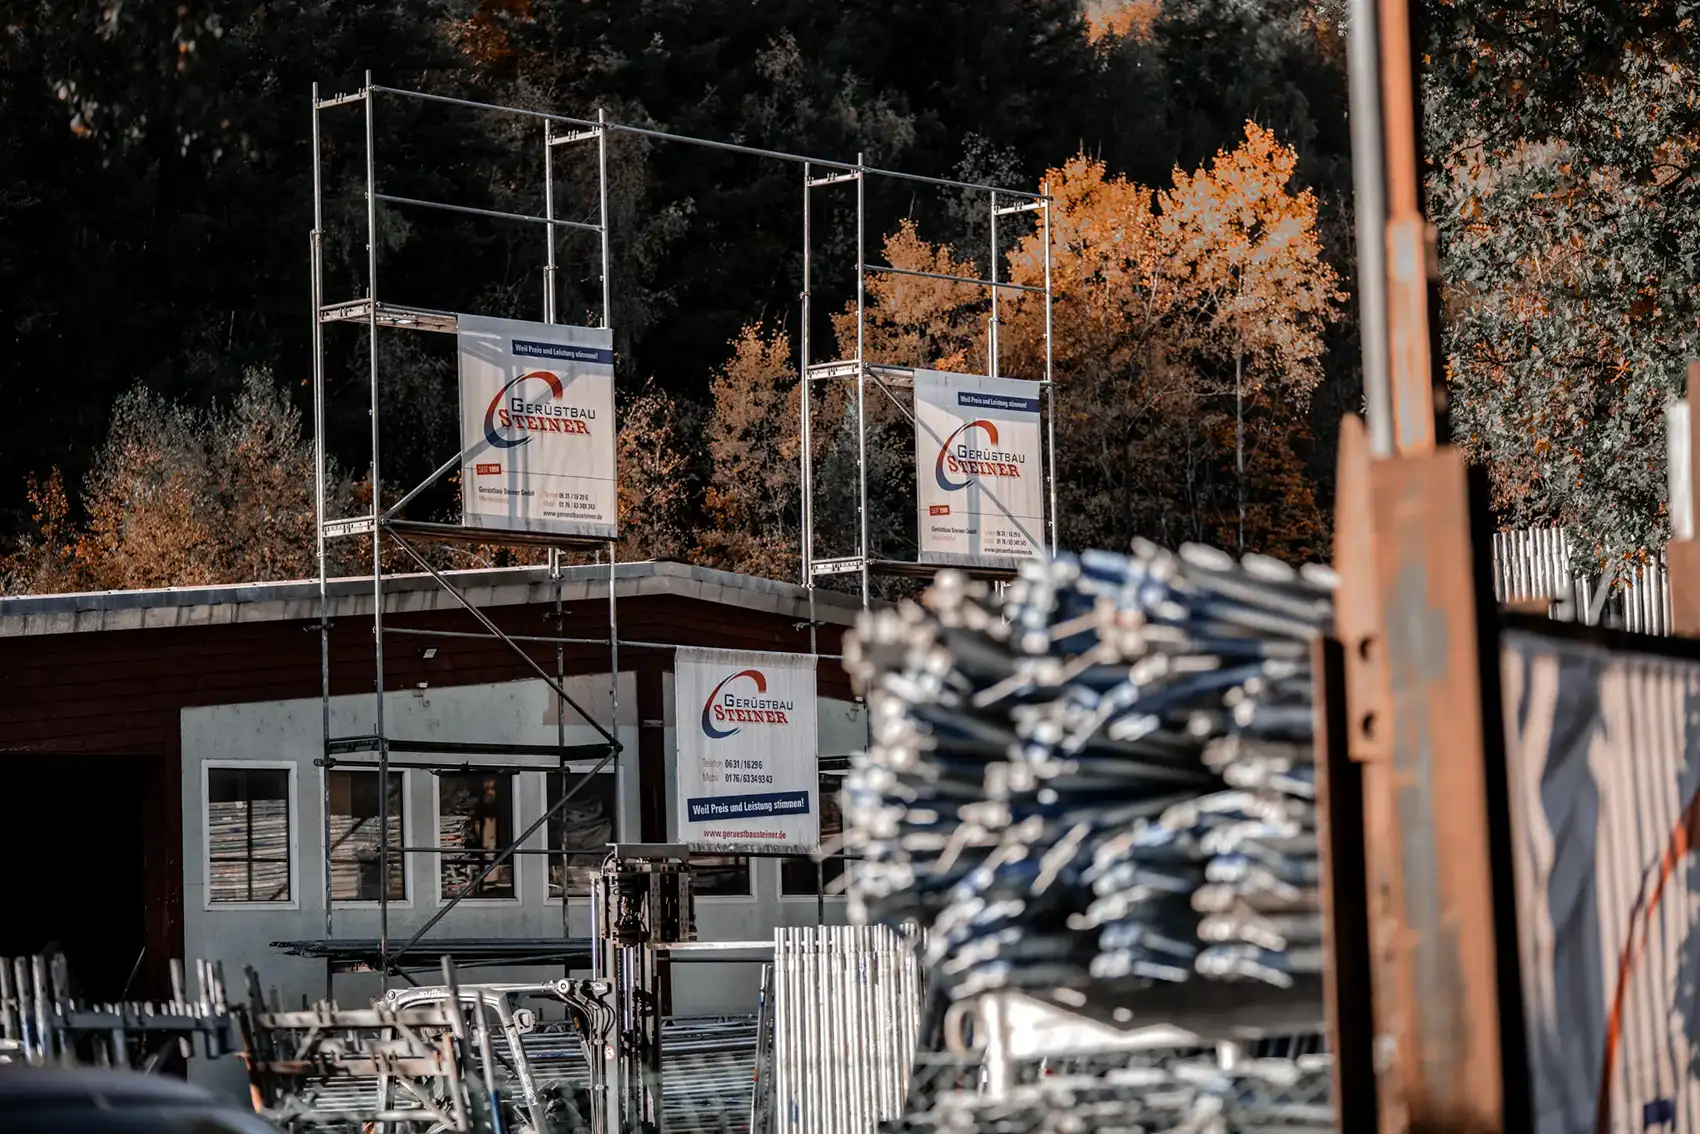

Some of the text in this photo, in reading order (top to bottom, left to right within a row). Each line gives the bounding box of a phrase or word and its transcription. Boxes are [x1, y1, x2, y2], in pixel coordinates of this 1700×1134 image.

[515, 343, 599, 360] Weil Preis und Leistung stimmen!
[960, 395, 971, 403] Weil
[971, 396, 982, 404] Preis
[982, 397, 991, 405] und
[991, 398, 1008, 408] Leistung
[498, 408, 591, 435] STEINER
[946, 455, 1021, 477] STEINER
[478, 485, 535, 497] Gerüstbau Steiner GmbH
[543, 511, 603, 520] www.geruestbausteiner.de
[713, 704, 789, 724] STEINER
[692, 797, 805, 815] Weil Preis und Leistung stimmen!
[703, 830, 787, 840] www.geruestbausteiner.de
